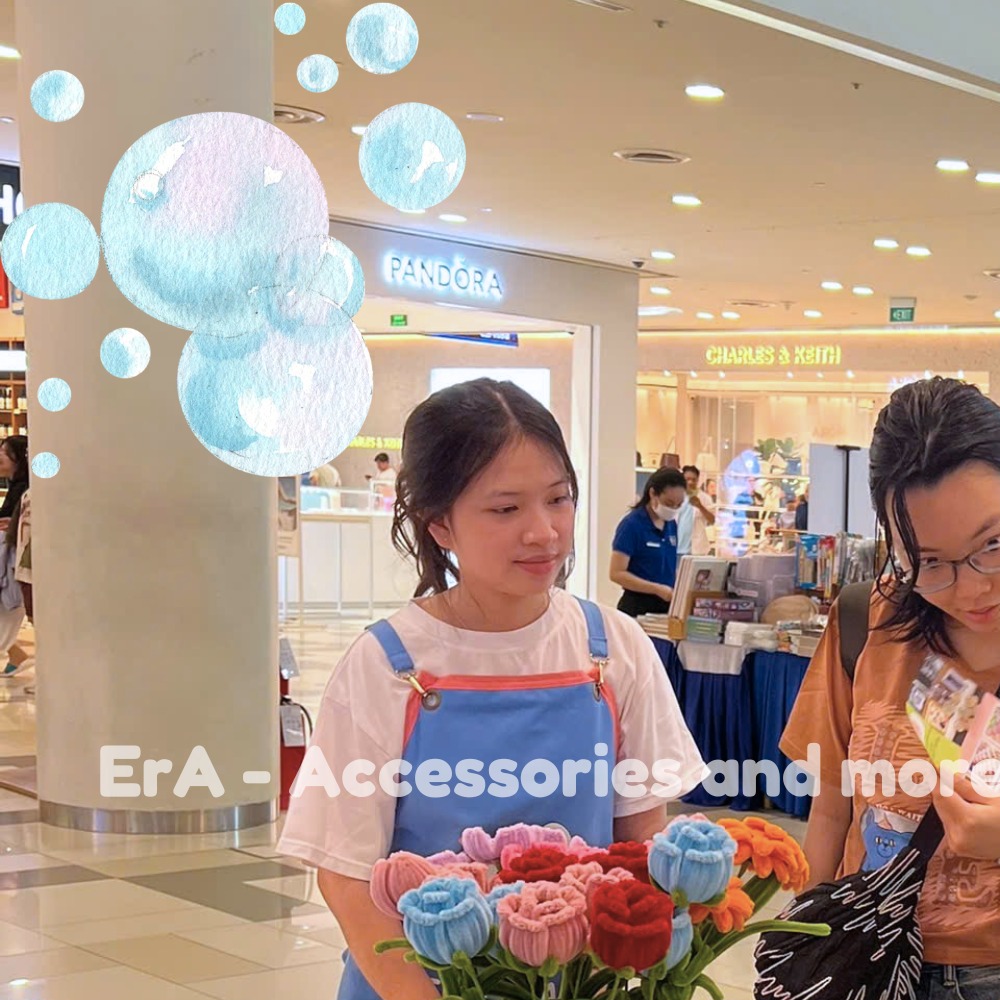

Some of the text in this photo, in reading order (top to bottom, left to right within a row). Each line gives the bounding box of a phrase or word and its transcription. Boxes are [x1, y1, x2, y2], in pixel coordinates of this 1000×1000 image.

[385, 253, 504, 299] PANDORA
[705, 344, 842, 366] CHARLES & KEITH
